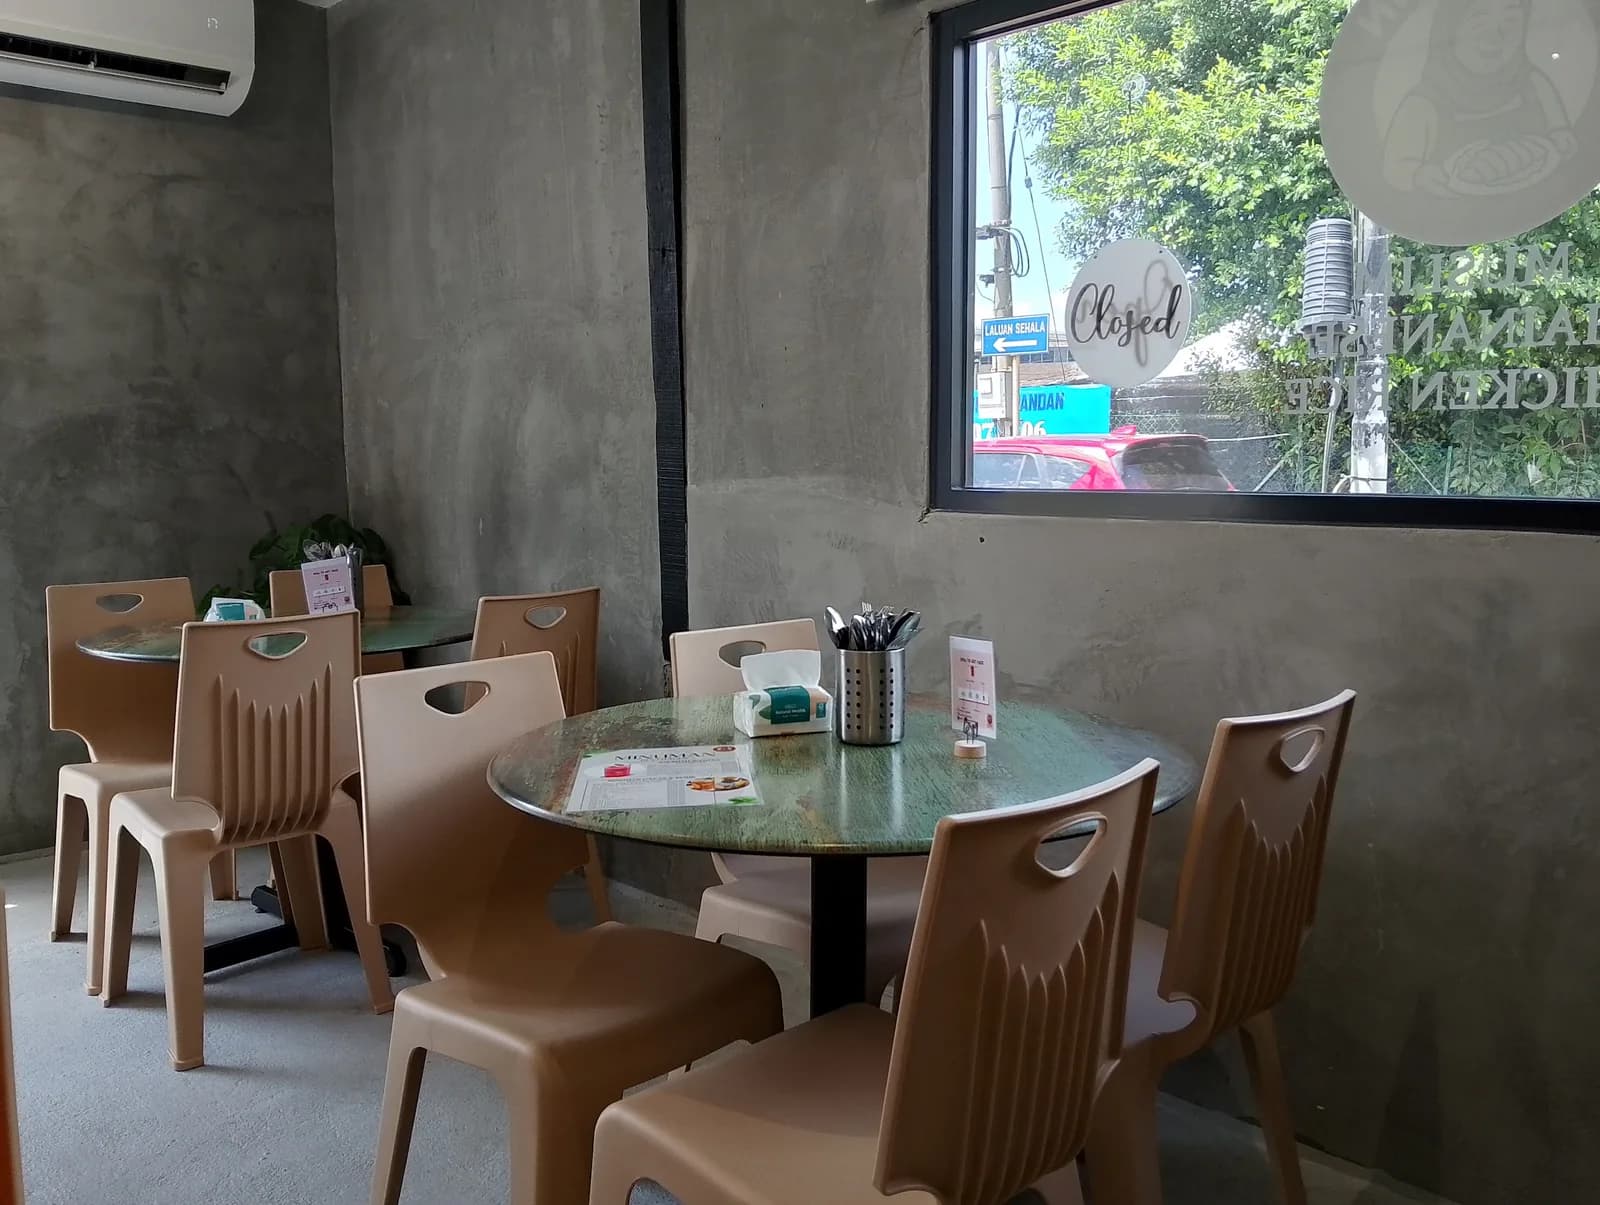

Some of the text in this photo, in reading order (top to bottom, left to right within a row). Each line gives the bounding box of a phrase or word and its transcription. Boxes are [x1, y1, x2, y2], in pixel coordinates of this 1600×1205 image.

[1071, 283, 1182, 347] Closed
[985, 321, 1045, 336] LALUAN SEHALA
[1020, 392, 1065, 411] ANDAN
